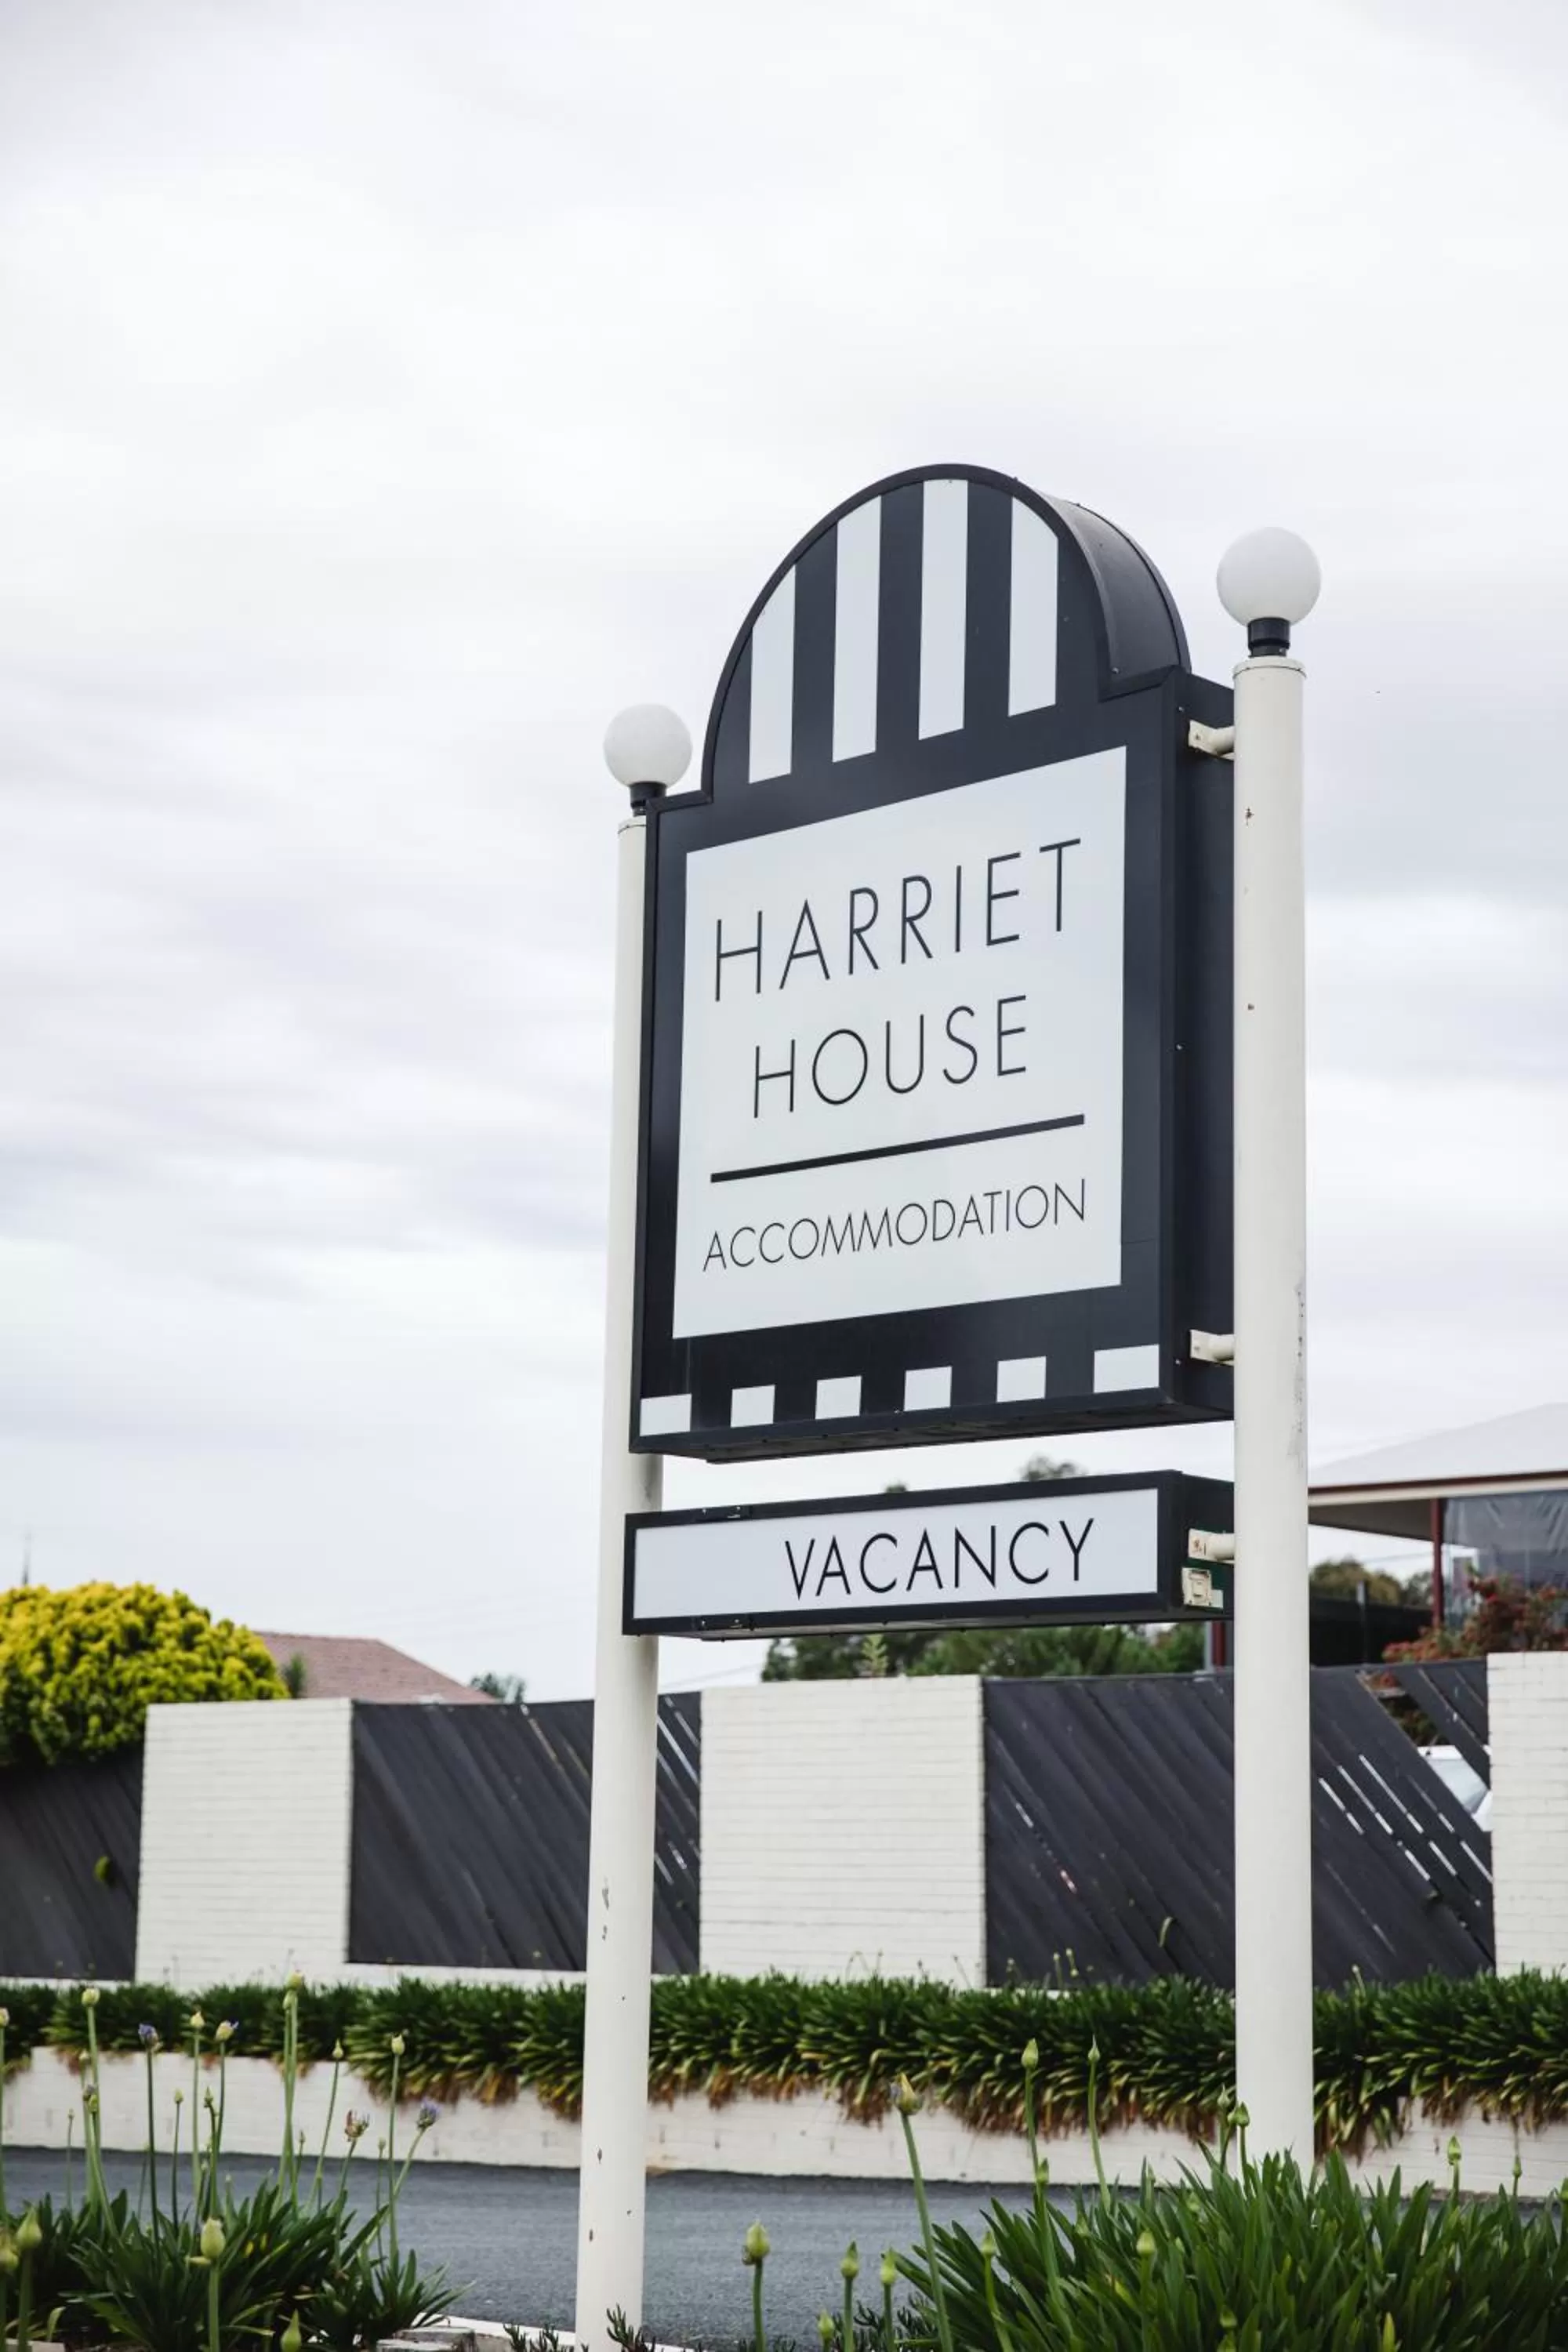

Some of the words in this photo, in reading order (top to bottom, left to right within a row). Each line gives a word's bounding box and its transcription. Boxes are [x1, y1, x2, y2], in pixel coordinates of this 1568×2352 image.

[715, 838, 1081, 1002] HARRIET
[753, 995, 1026, 1119] HOUSE
[702, 1178, 1085, 1272] ACCOMMODATION
[785, 1518, 1094, 1600] VACANCY
